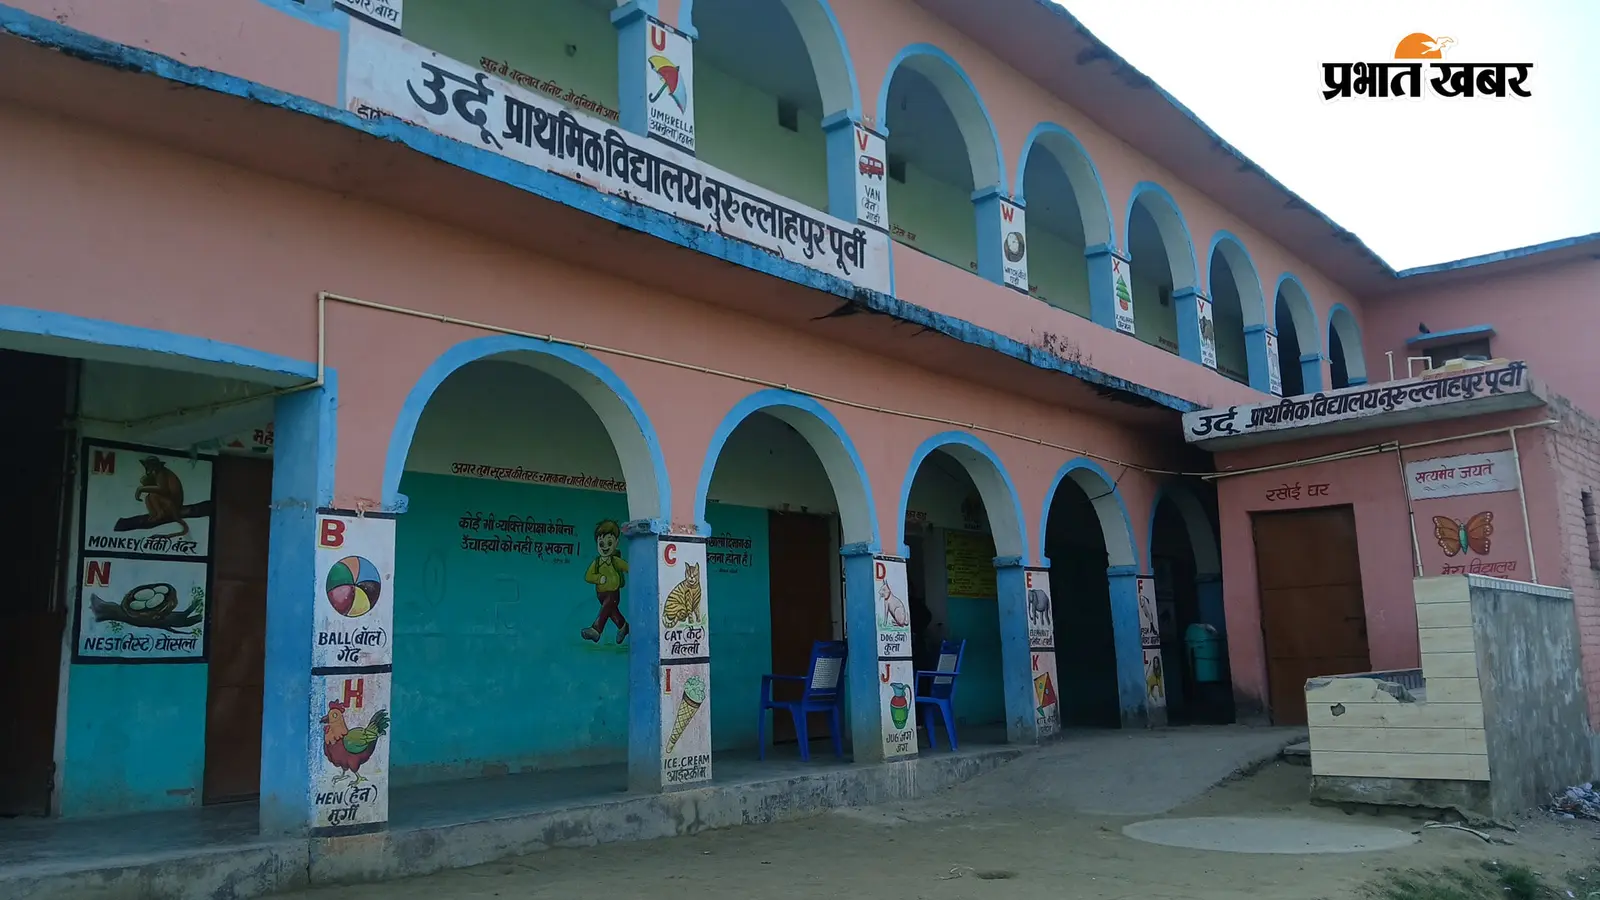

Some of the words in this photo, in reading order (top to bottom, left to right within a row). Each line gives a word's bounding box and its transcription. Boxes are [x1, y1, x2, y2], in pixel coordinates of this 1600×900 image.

[375, 4, 399, 22] बाघ
[651, 25, 665, 51] U
[651, 108, 693, 135] UMBRELLA
[857, 130, 868, 151] V
[407, 62, 503, 150] उर्दू
[502, 95, 604, 172] प्राथमिक
[604, 129, 701, 210] विद्यालय
[702, 177, 826, 259] नुरुल्लाहपुर
[827, 227, 867, 275] पूर्वी
[865, 185, 880, 202] VAN
[1001, 204, 1014, 222] W
[1113, 259, 1120, 274] X
[1198, 300, 1205, 313] Y
[1267, 335, 1272, 347] Z
[1192, 406, 1241, 436] उर्दू
[1245, 399, 1310, 428] प्राथमिक
[1310, 389, 1378, 418] विद्यालय
[1485, 361, 1527, 394] पूर्वी
[94, 451, 115, 474] M
[452, 462, 476, 474] अगर
[1415, 464, 1454, 483] सत्यमेव
[1458, 459, 1494, 479] जयते
[1266, 481, 1301, 501] रसोई
[1308, 483, 1331, 497] घर
[459, 511, 483, 533] कोई
[483, 512, 495, 531] भी
[318, 518, 346, 549] B
[88, 536, 140, 551] MONKEY
[172, 537, 198, 554] बंदर
[664, 544, 677, 566] C
[85, 560, 111, 587] N
[875, 562, 887, 581] D
[1468, 557, 1516, 574] विद्यालय
[1026, 572, 1032, 588] E
[1138, 580, 1143, 593] F
[84, 637, 121, 651] NEST
[318, 632, 351, 646] BALL
[351, 626, 387, 648] (बॉल)
[665, 631, 682, 641] CAT
[880, 633, 893, 642] DOG
[671, 640, 700, 656] बिल्ली
[1032, 655, 1039, 671] K
[1143, 651, 1148, 664] L
[664, 669, 672, 693] I
[880, 664, 890, 683] J
[343, 678, 364, 708] H
[886, 733, 898, 743] JUG
[664, 755, 709, 770] ICE.CREAM
[315, 791, 343, 804] HEN
[327, 804, 360, 826] मुर्गी
